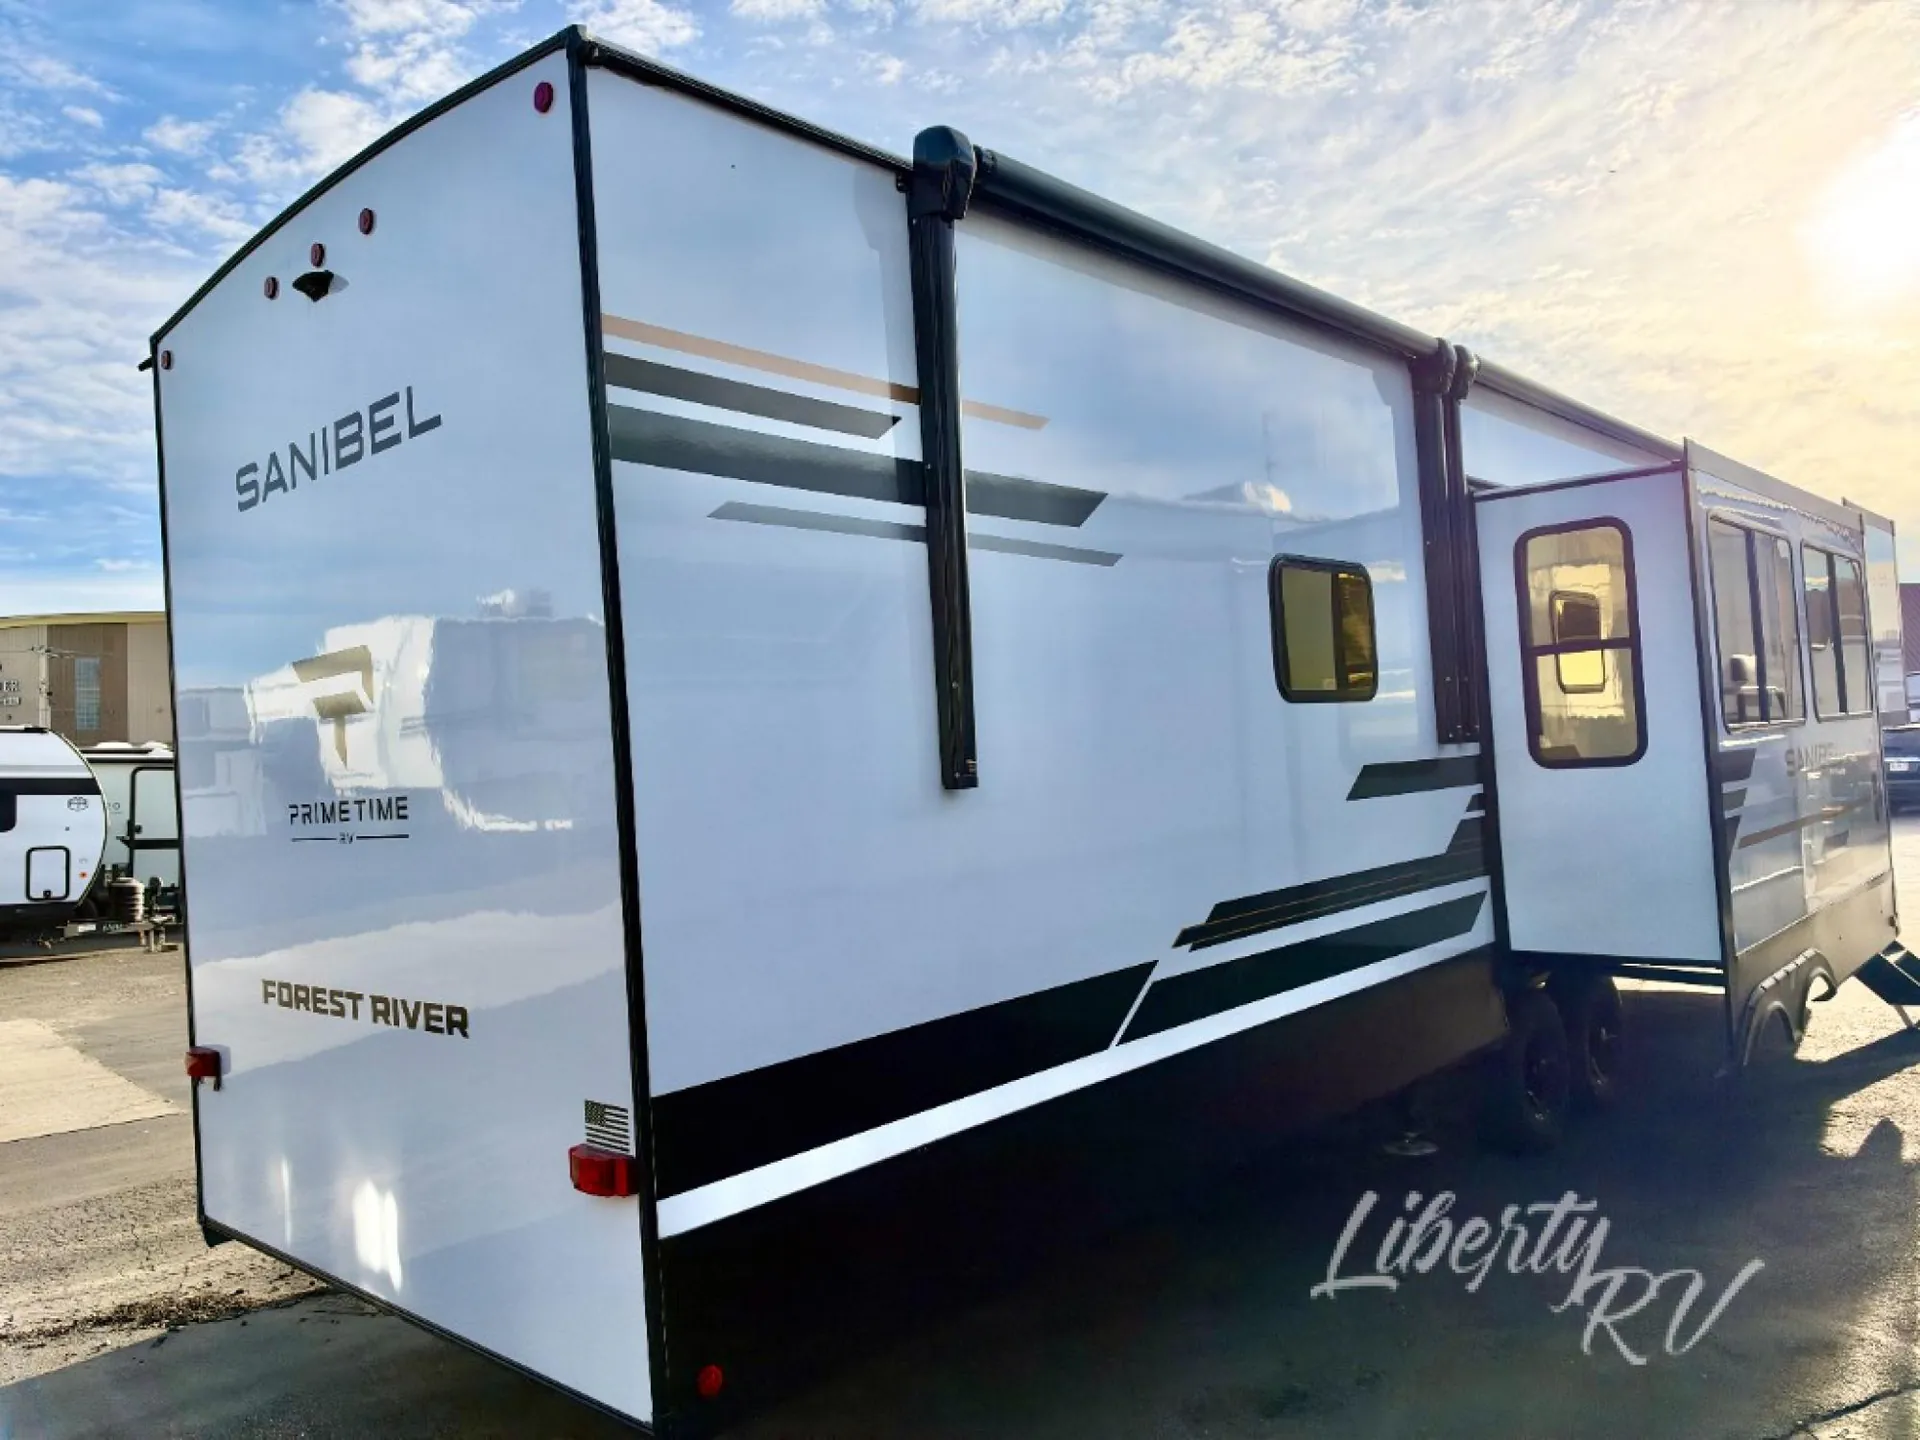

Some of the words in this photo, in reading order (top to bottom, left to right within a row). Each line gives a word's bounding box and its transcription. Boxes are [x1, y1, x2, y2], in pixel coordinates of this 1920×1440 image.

[235, 385, 442, 512] SANIBEL
[288, 796, 410, 826] PRIMETIME
[261, 978, 364, 1021] FOREST
[369, 994, 470, 1039] RIVER
